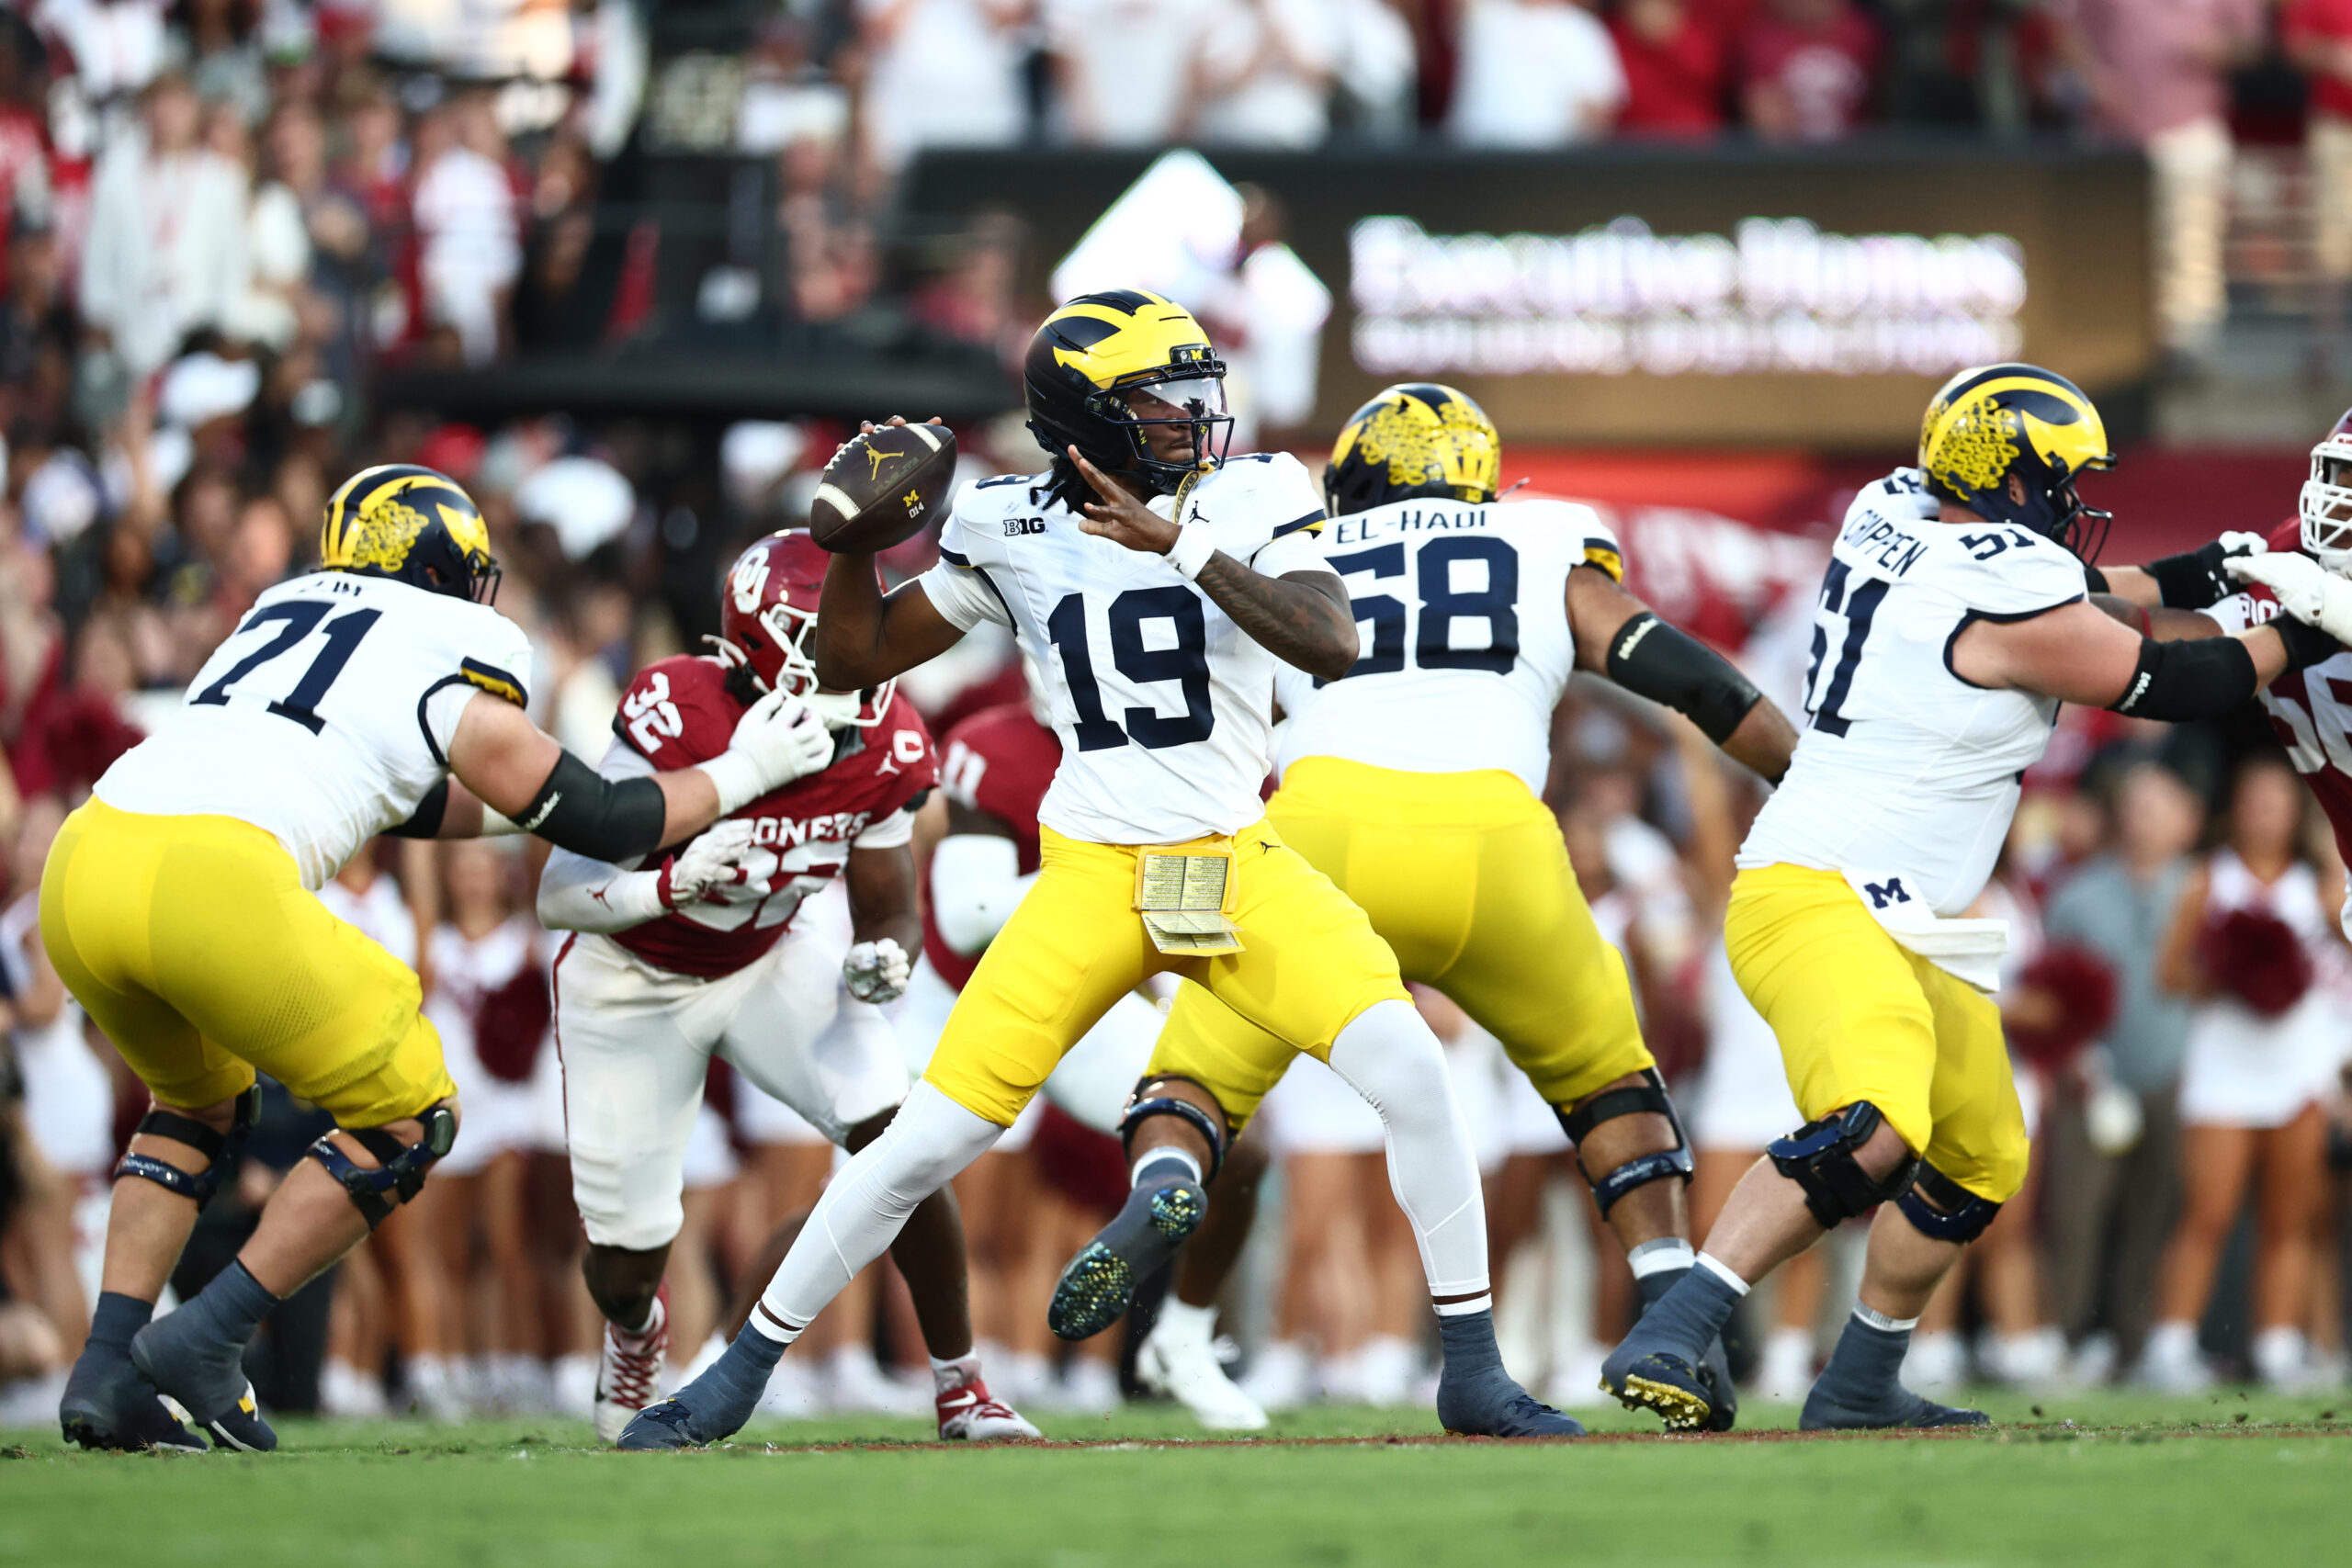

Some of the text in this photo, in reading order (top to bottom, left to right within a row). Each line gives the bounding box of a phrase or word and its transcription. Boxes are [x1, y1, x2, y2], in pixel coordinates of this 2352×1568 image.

[903, 489, 920, 507] M
[1337, 510, 1486, 544] EL-HADI
[1959, 529, 2036, 560] 51
[1312, 536, 1519, 690] 58
[189, 600, 383, 736] 71
[1048, 585, 1215, 752] 19
[623, 671, 684, 754] 32
[893, 729, 924, 763] C
[1863, 877, 1911, 909] M
